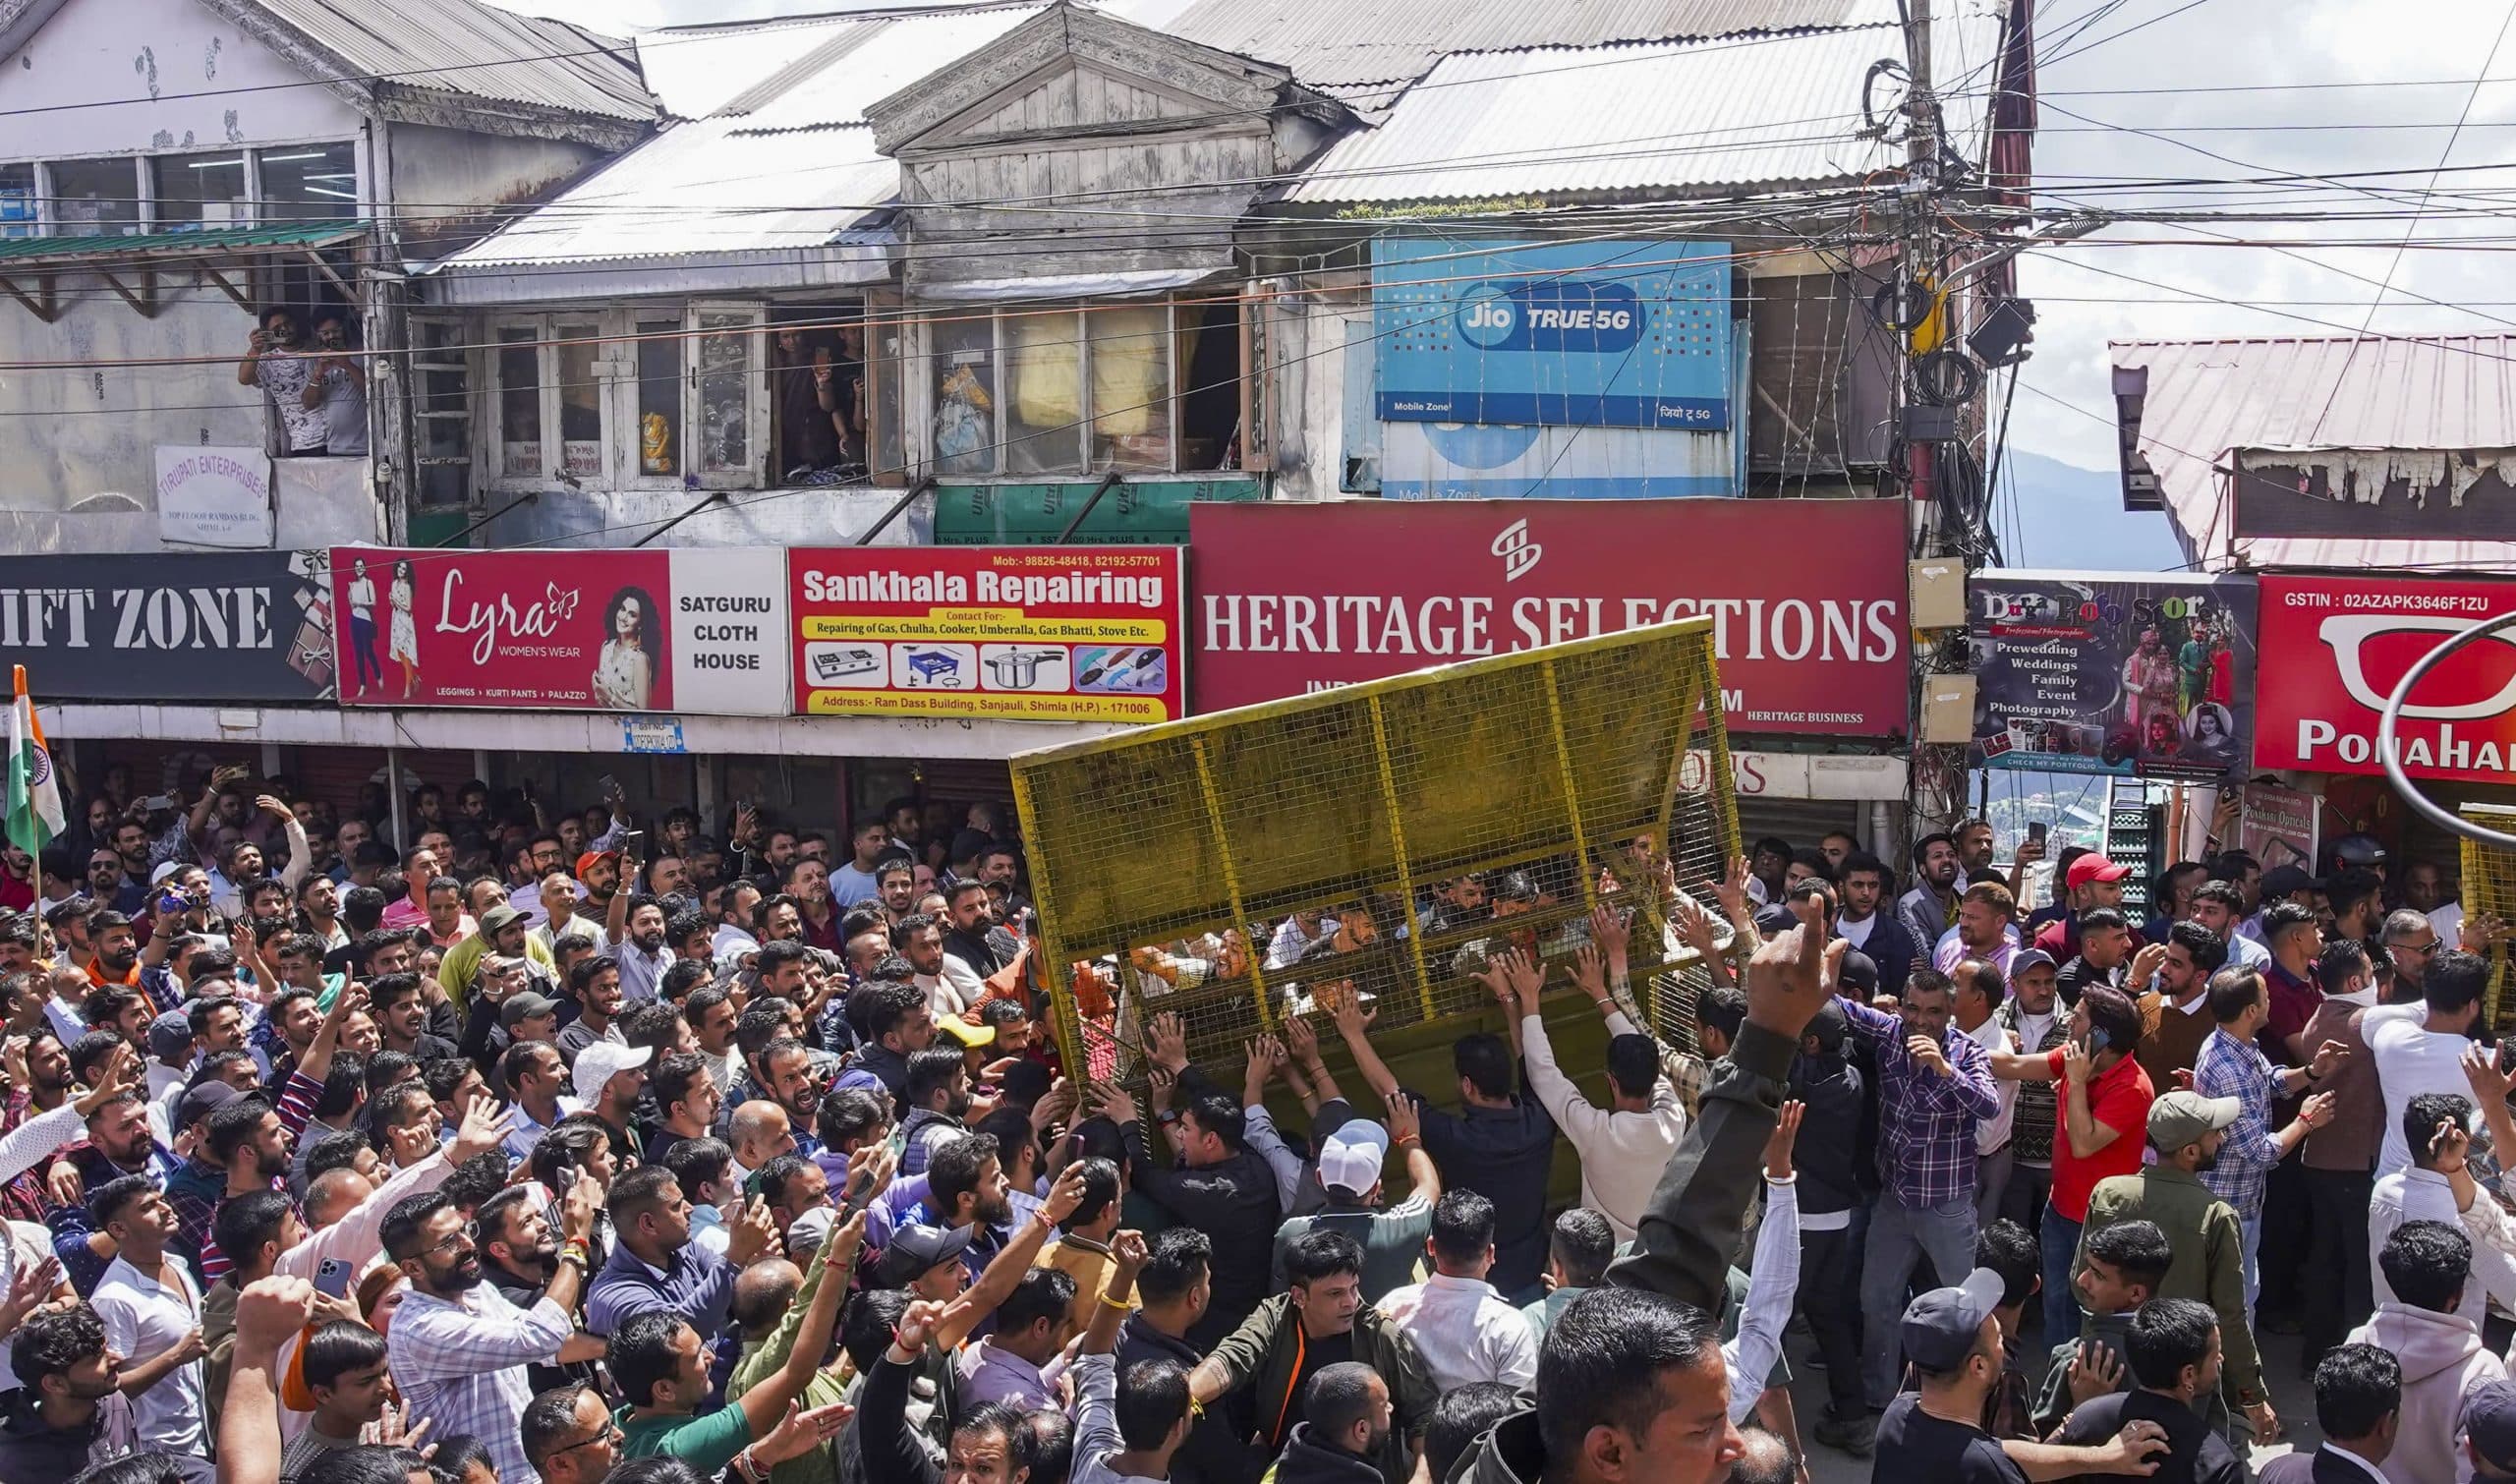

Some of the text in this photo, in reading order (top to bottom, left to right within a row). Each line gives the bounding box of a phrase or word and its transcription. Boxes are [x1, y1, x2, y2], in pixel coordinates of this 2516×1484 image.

[1466, 301, 1511, 328] Jio
[1394, 402, 1450, 411] Mobile Zone
[1695, 409, 1710, 420] 5G
[1399, 489, 1443, 500] Mobe
[993, 555, 1161, 567] Mob:- 98826-48418, 82192-57701
[803, 570, 1163, 608] Sankhala Repairing
[679, 596, 772, 613] SATGURU
[2285, 592, 2330, 606] GSTIN
[2344, 594, 2488, 611] 02AZAPK3646F1ZU
[113, 587, 273, 650] ZONE
[435, 568, 557, 666] Lyra
[946, 611, 1005, 621] Contact For:-
[693, 624, 758, 642] CLOTH
[817, 622, 1149, 637] Repairing of Gas, Chulha, Cooker, Umberalla, Gas Bhatti, Stove Etc.
[1203, 595, 1494, 656] HERITAGE
[499, 646, 581, 657] WOMEN'S WEAR
[1996, 642, 2079, 657] Prewedding
[693, 653, 761, 669] HOUSE
[2011, 657, 2078, 672] Weddings
[2030, 673, 2078, 688] Family
[436, 688, 587, 700] LEGGINGS KURTI PANTS PALAZZO
[2036, 689, 2078, 701] Event
[823, 696, 872, 708] Address:-
[875, 697, 897, 708] Ram
[900, 698, 927, 709] Dass
[930, 698, 977, 712] Building,
[980, 699, 1027, 713] Sanjauli,
[1029, 700, 1067, 712] Shimla
[1070, 702, 1100, 714] (H.P.)
[1110, 703, 1150, 714] 171006
[1989, 702, 2077, 717] Photography
[1746, 711, 1864, 723] HERITAGE BUSINESS
[2051, 761, 2096, 770] PORTFOLIO
